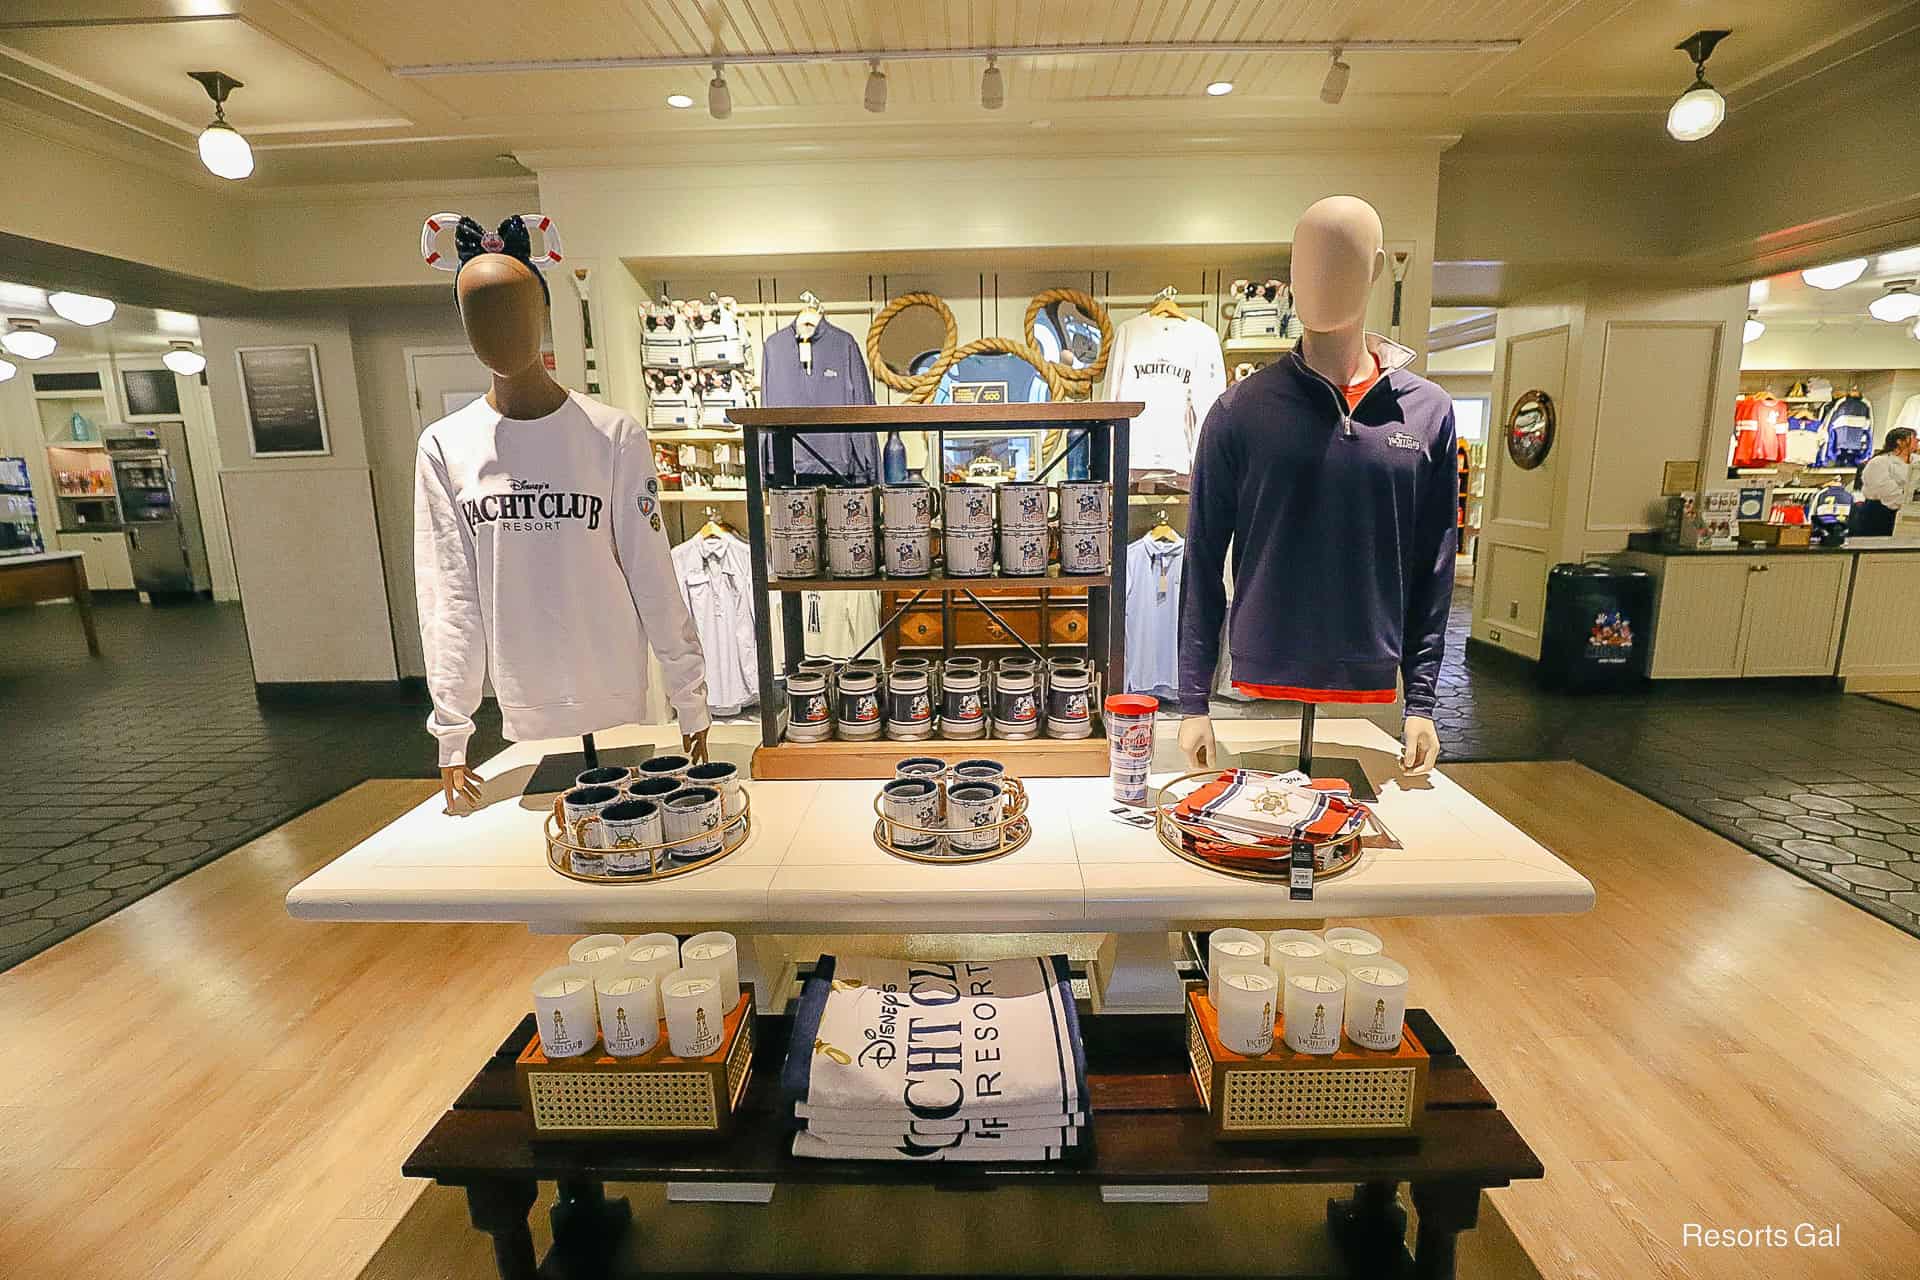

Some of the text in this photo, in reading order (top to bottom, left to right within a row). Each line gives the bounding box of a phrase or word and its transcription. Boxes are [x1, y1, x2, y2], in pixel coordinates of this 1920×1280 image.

[462, 493, 603, 536] YACHT CLUB
[503, 521, 561, 532] RESORT
[858, 983, 909, 1069] Disney's
[966, 963, 1002, 1097] RESORT
